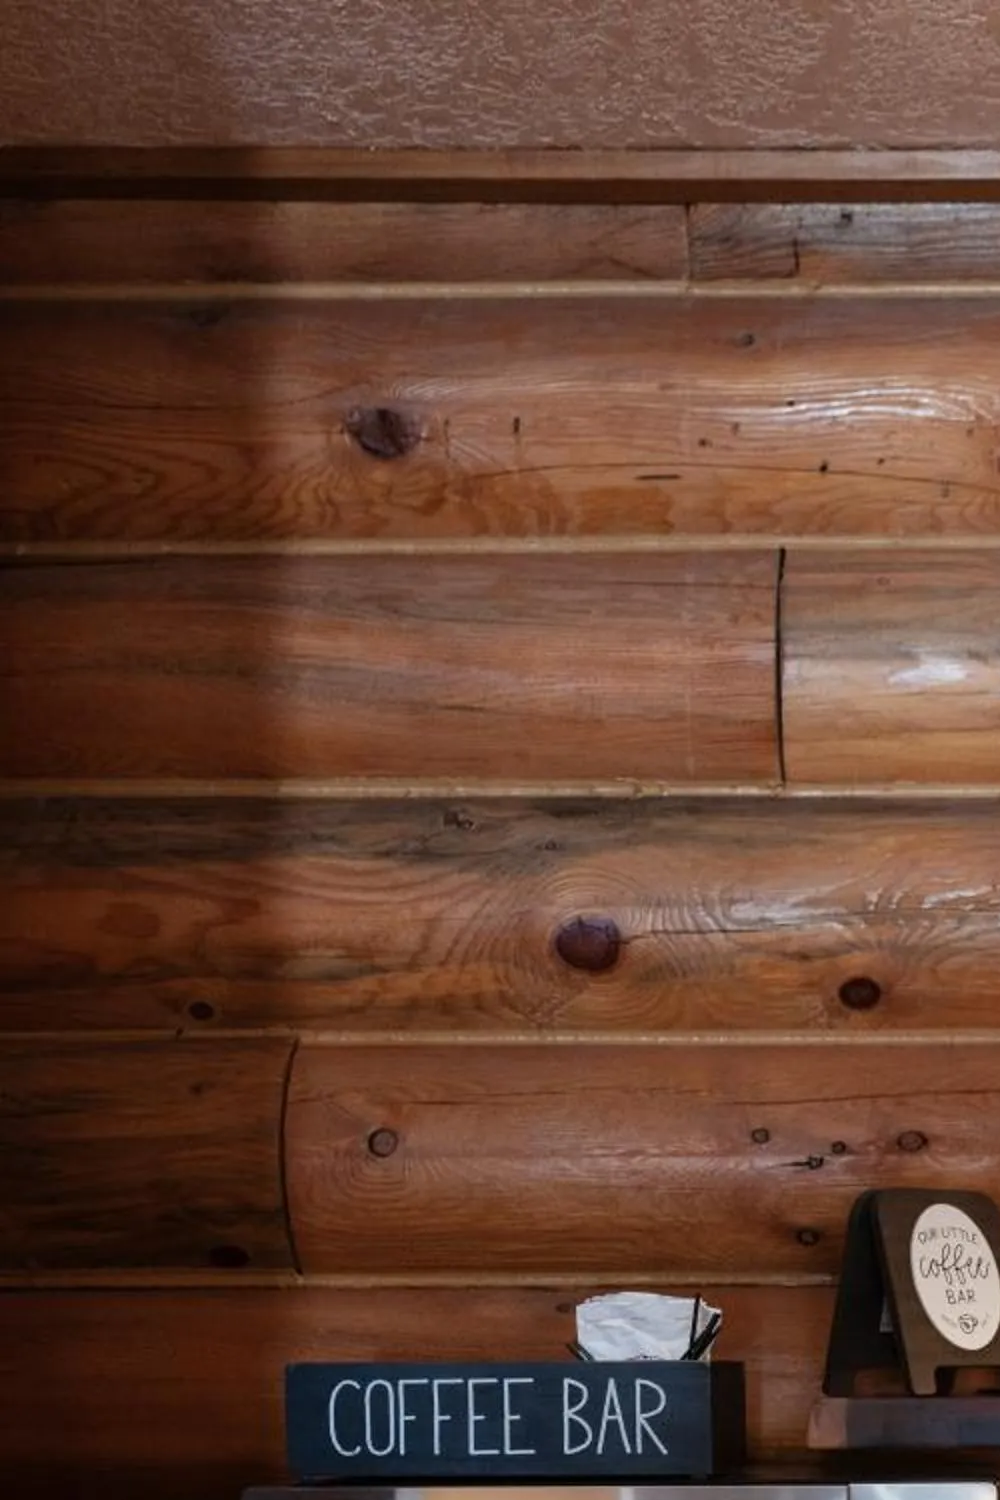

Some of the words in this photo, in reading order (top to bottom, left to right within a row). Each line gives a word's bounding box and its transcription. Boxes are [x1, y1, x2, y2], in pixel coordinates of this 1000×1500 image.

[941, 1227, 978, 1245] LITTLE
[919, 1243, 991, 1286] coffee
[945, 1288, 976, 1305] BAR
[328, 1377, 536, 1457] COFFEE
[563, 1377, 669, 1456] BAR
